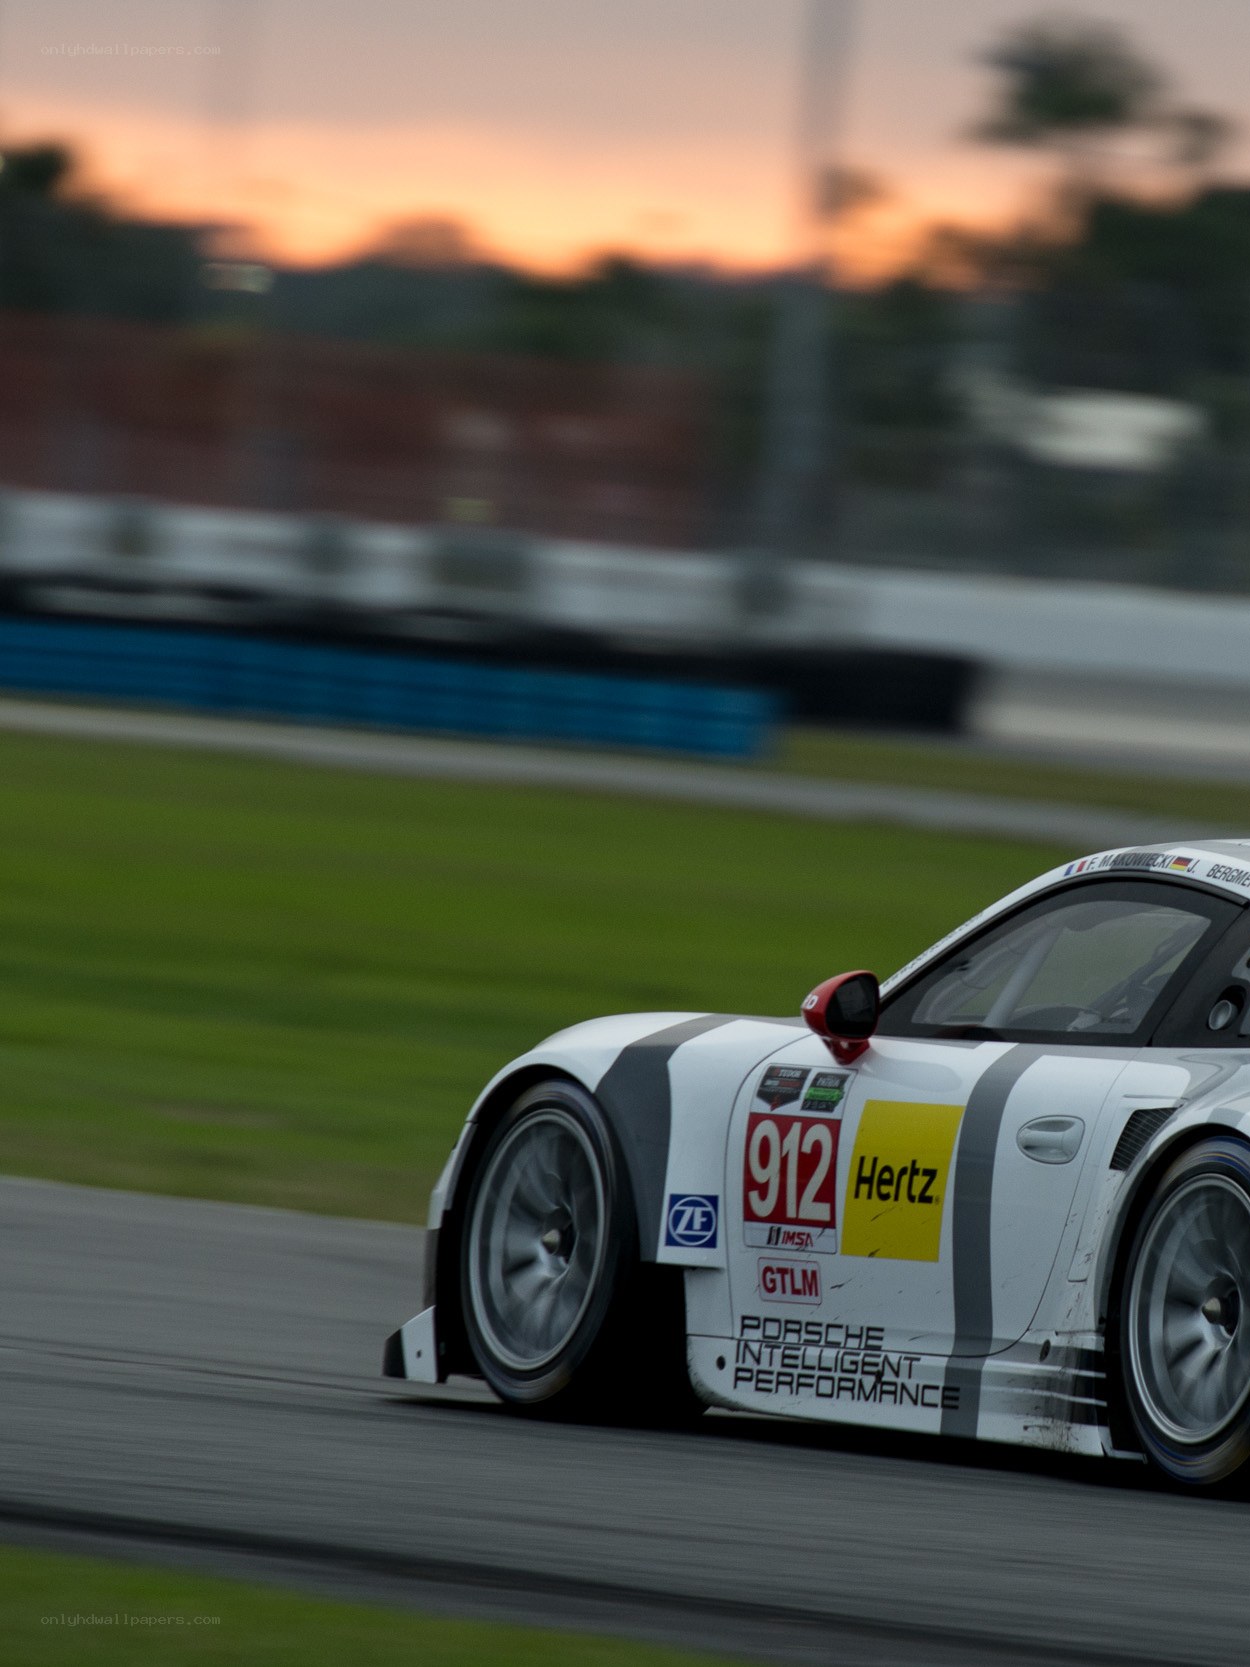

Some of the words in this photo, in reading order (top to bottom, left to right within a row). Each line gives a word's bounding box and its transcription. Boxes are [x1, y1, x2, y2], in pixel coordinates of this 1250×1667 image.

[1086, 857, 1099, 870] F.
[1099, 853, 1174, 868] MAKOWIECKI
[1187, 859, 1200, 873] J.
[748, 1119, 832, 1222] 912
[853, 1155, 938, 1204] Hertz
[781, 1230, 814, 1247] IMSA
[761, 1265, 820, 1298] GTLM
[740, 1315, 885, 1351] PORSCHE
[735, 1339, 921, 1380] INTELLIGENT
[733, 1366, 961, 1410] PERFORMANCE
